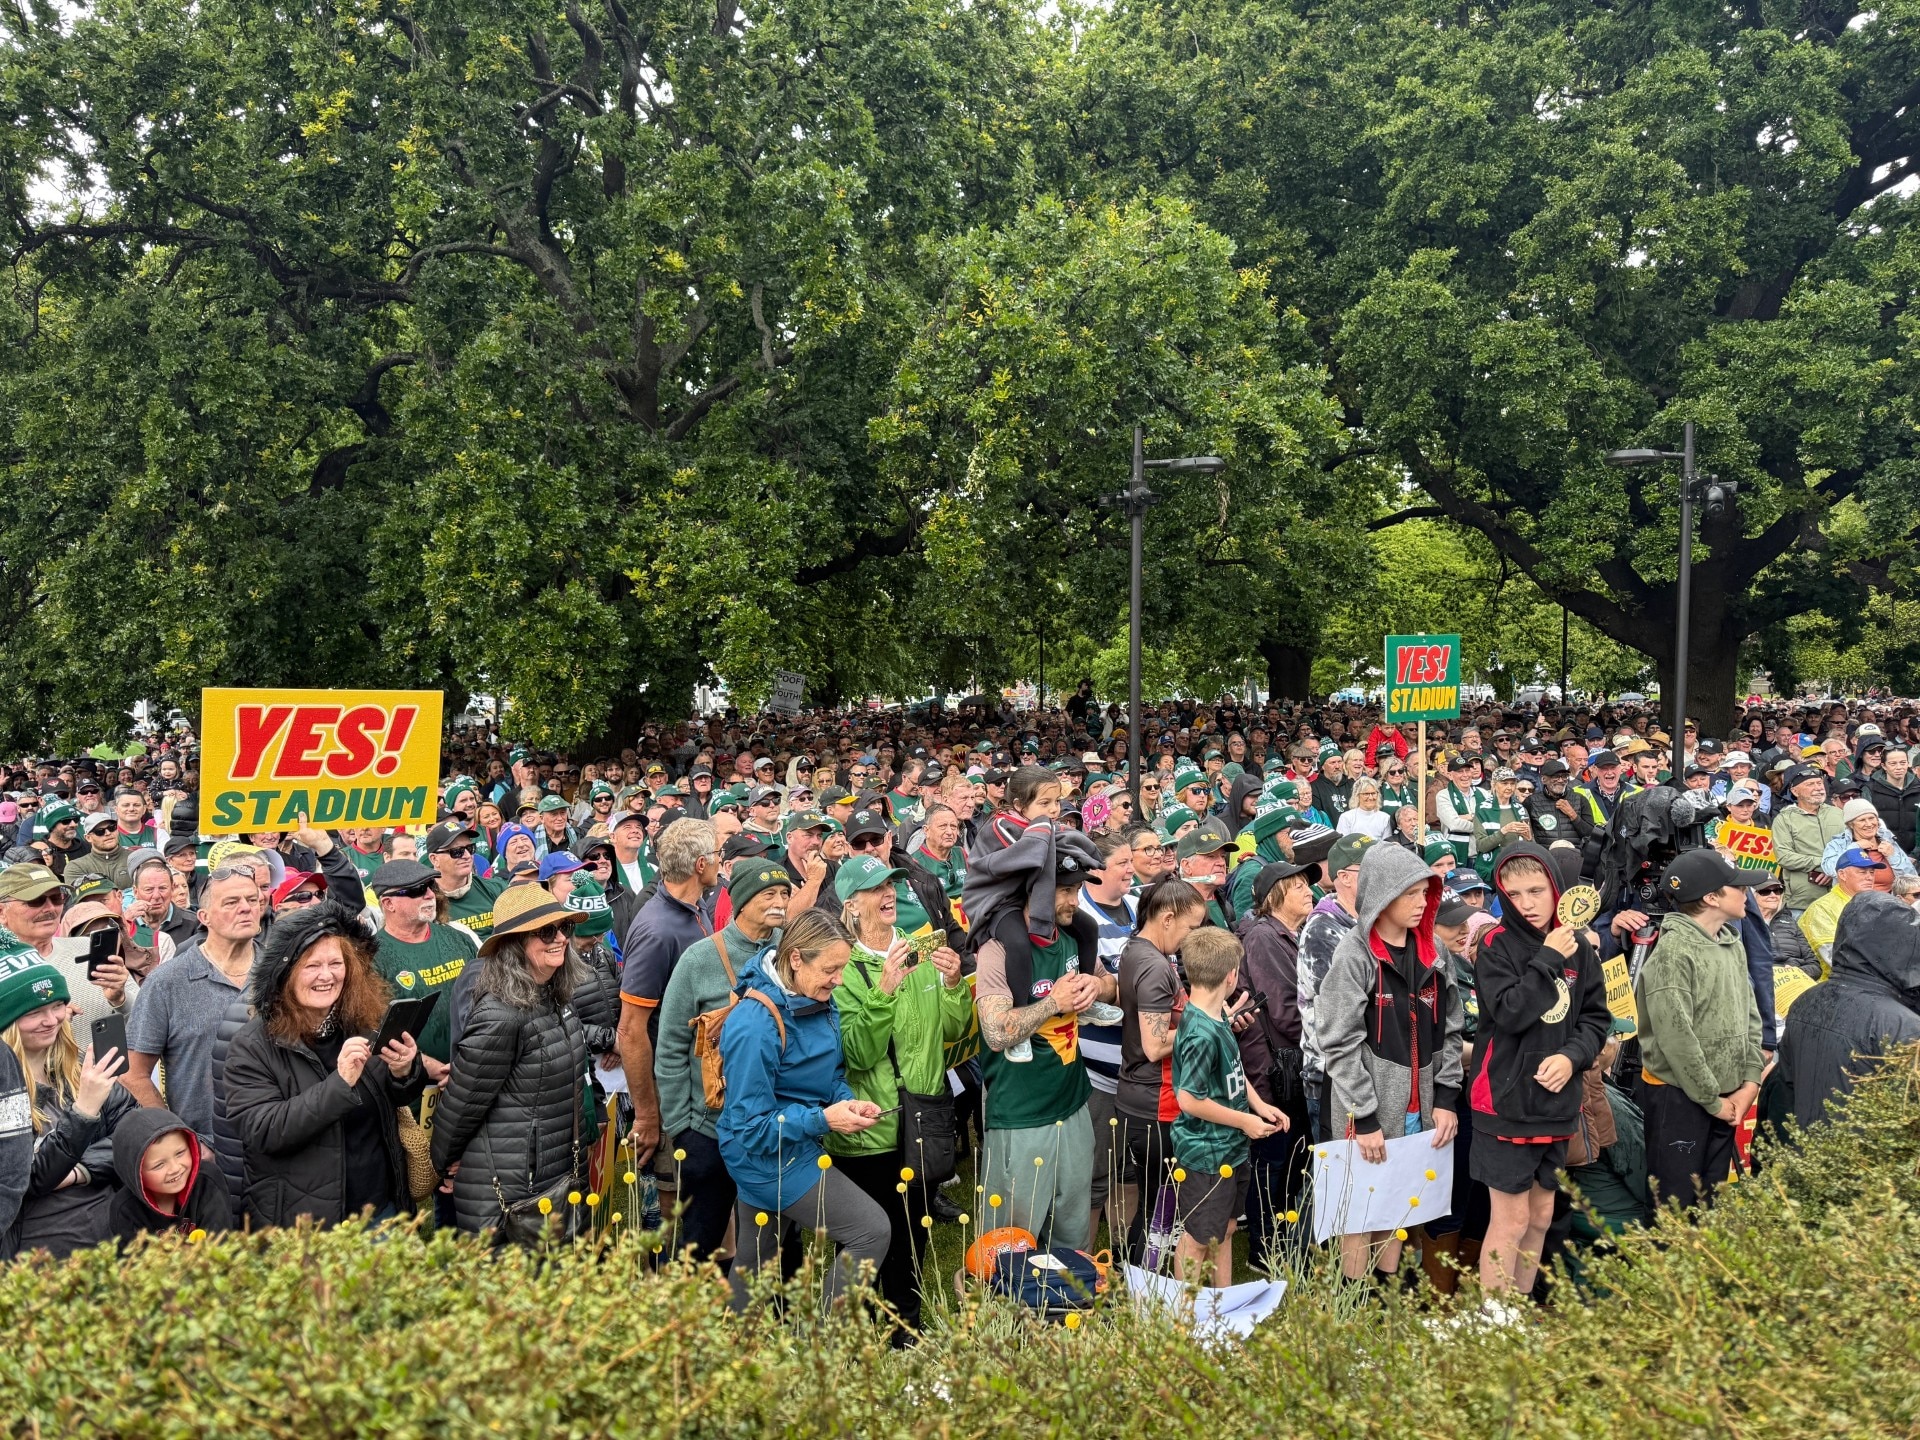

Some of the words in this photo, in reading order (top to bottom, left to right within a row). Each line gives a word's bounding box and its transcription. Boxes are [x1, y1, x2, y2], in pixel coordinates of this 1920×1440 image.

[1396, 645, 1451, 684] YES!
[1390, 686, 1457, 713] STADIUM
[228, 704, 419, 780] YES!
[211, 786, 428, 827] STADIUM
[1727, 830, 1773, 857] YES!
[1737, 855, 1778, 873] ADIUM
[1567, 888, 1580, 897] YES
[1582, 888, 1594, 896] AFL
[468, 915, 480, 924] AFL
[1561, 917, 1590, 928] STDIUM
[418, 969, 431, 978] YES
[433, 964, 447, 976] AFL
[445, 958, 466, 970] TEAM
[1611, 962, 1626, 977] AFL
[33, 982, 53, 993] DEVILS
[424, 975, 437, 986] YES
[1033, 983, 1053, 995] AFL
[997, 1244, 1010, 1253] nab
